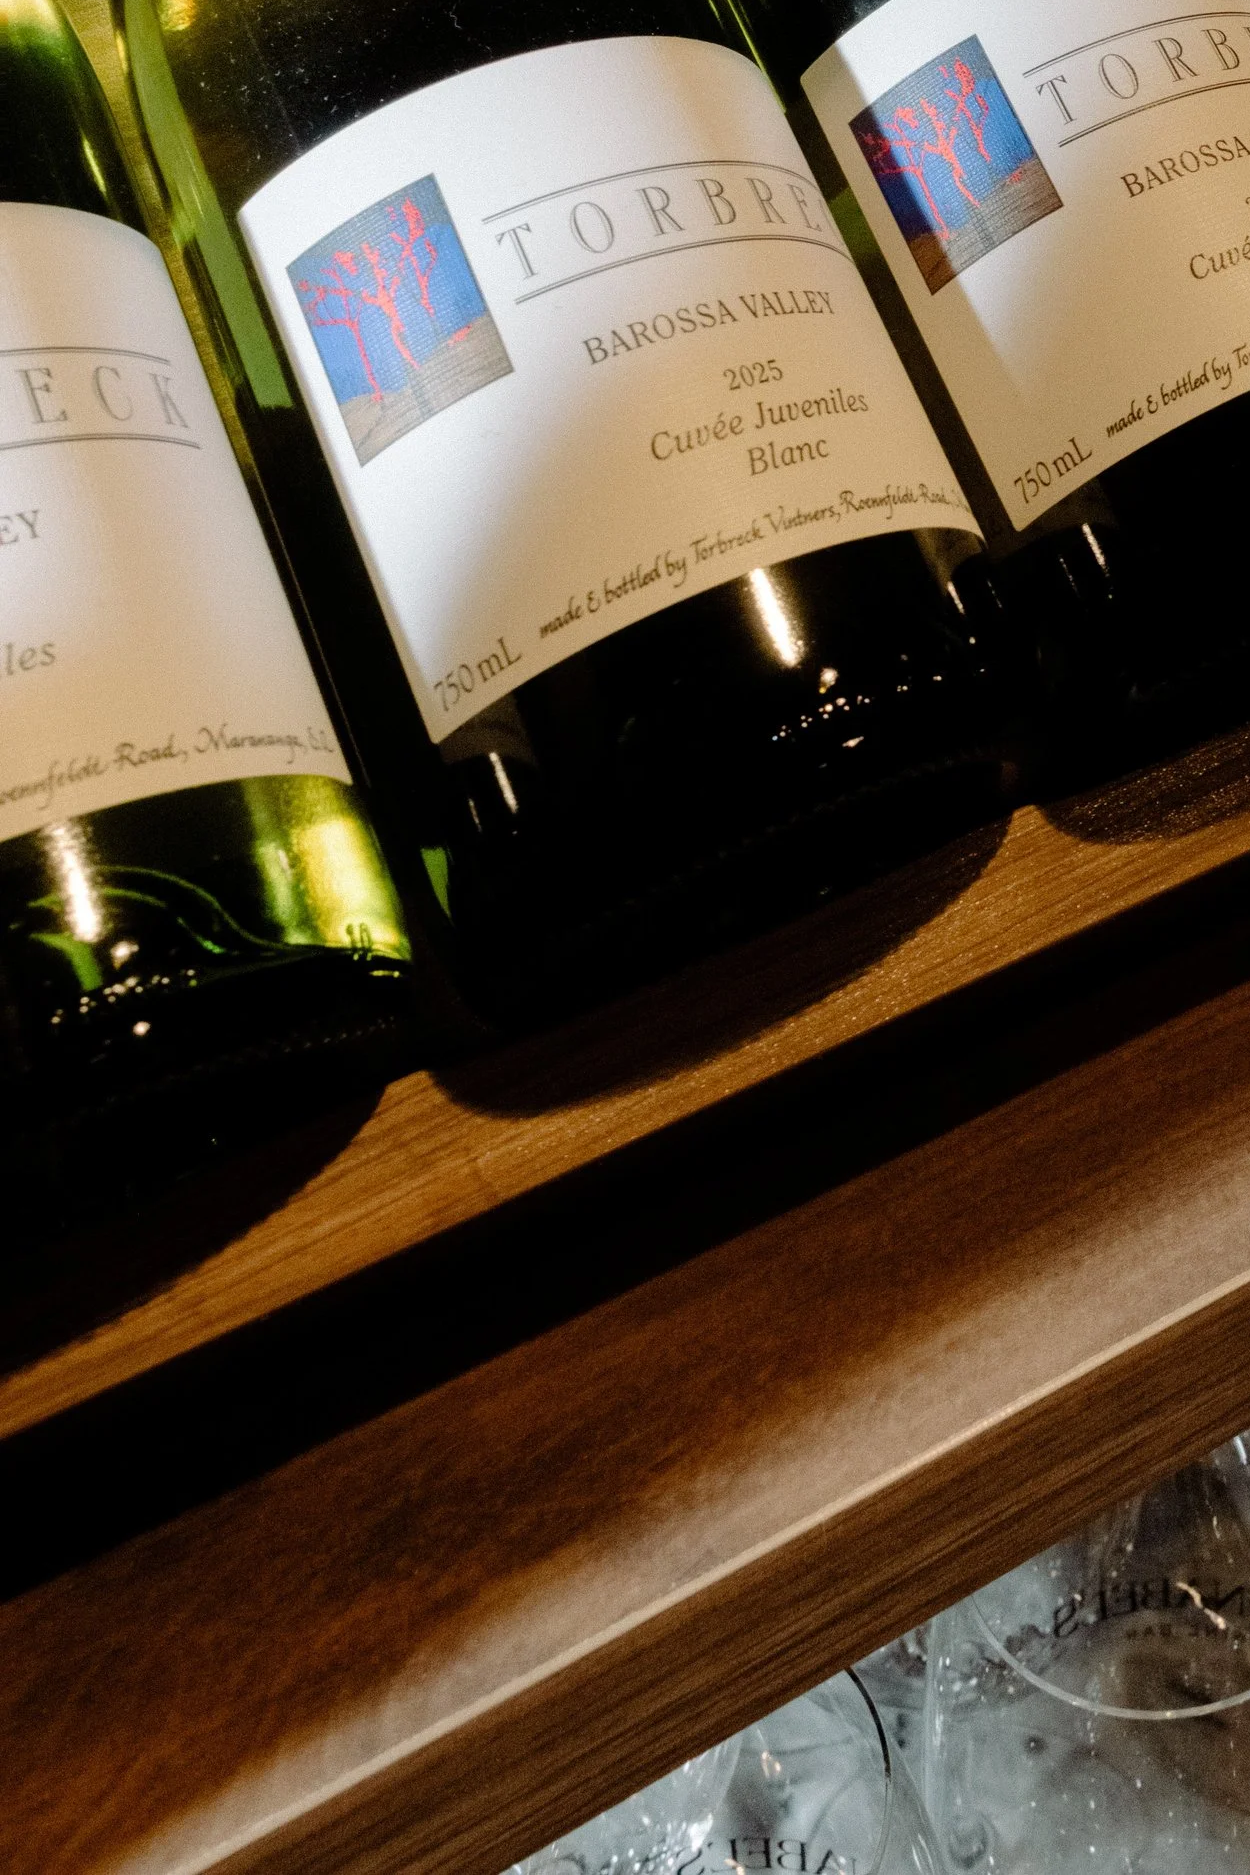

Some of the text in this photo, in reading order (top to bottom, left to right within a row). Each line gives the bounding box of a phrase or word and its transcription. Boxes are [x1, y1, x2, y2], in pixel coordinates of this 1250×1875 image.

[494, 176, 832, 281] TORBRE
[581, 289, 836, 365] BAROSSA VALLEY
[722, 358, 784, 392] 2025
[1105, 399, 1145, 438] made
[1160, 361, 1210, 407] bottled
[1211, 357, 1233, 391] by
[650, 387, 870, 461] Cuvée Juveniles
[747, 437, 831, 476] Blanc
[538, 593, 584, 640] made
[603, 554, 662, 605] bottled
[663, 549, 688, 589] by
[689, 525, 766, 565] Torbreck
[763, 505, 842, 536] Vintners,
